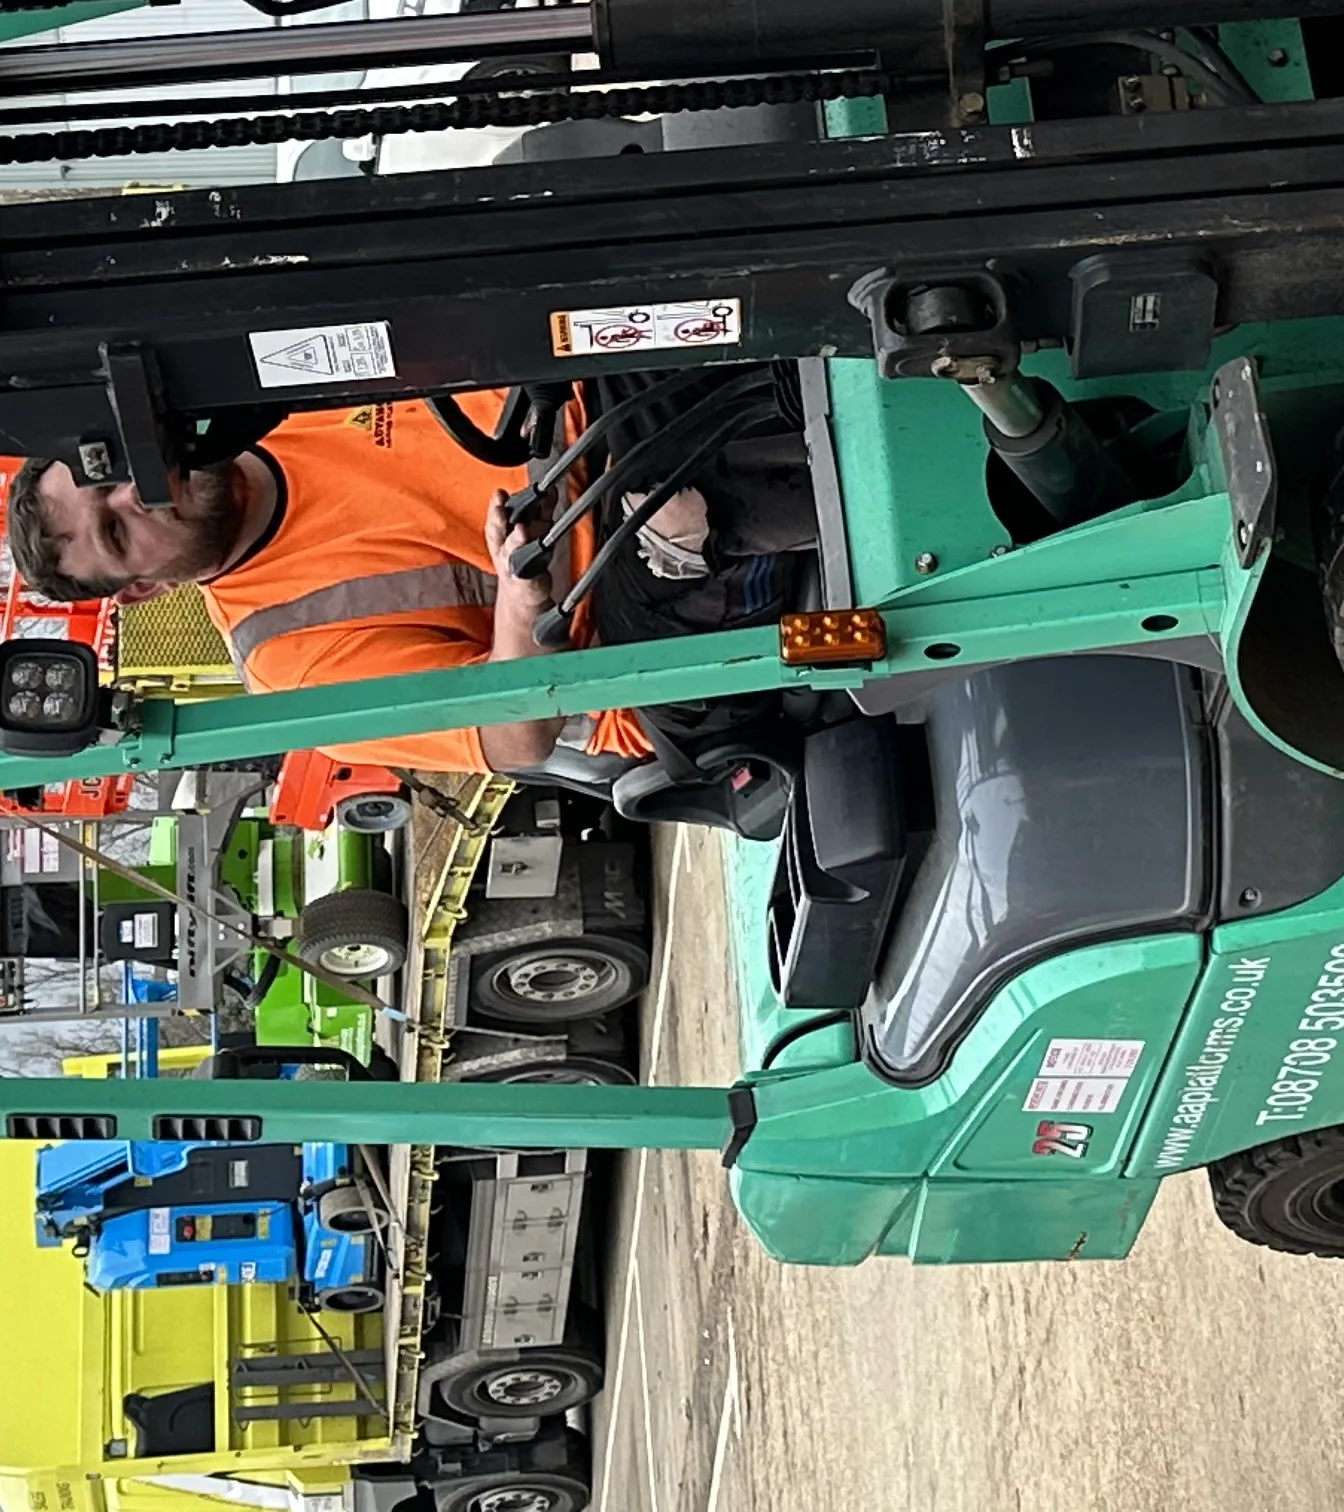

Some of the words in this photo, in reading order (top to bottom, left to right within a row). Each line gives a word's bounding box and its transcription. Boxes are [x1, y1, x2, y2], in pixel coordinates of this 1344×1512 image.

[79, 777, 103, 799] JC
[1153, 956, 1272, 1169] www.aaplatforms.co.uk
[1031, 1119, 1094, 1159] 25
